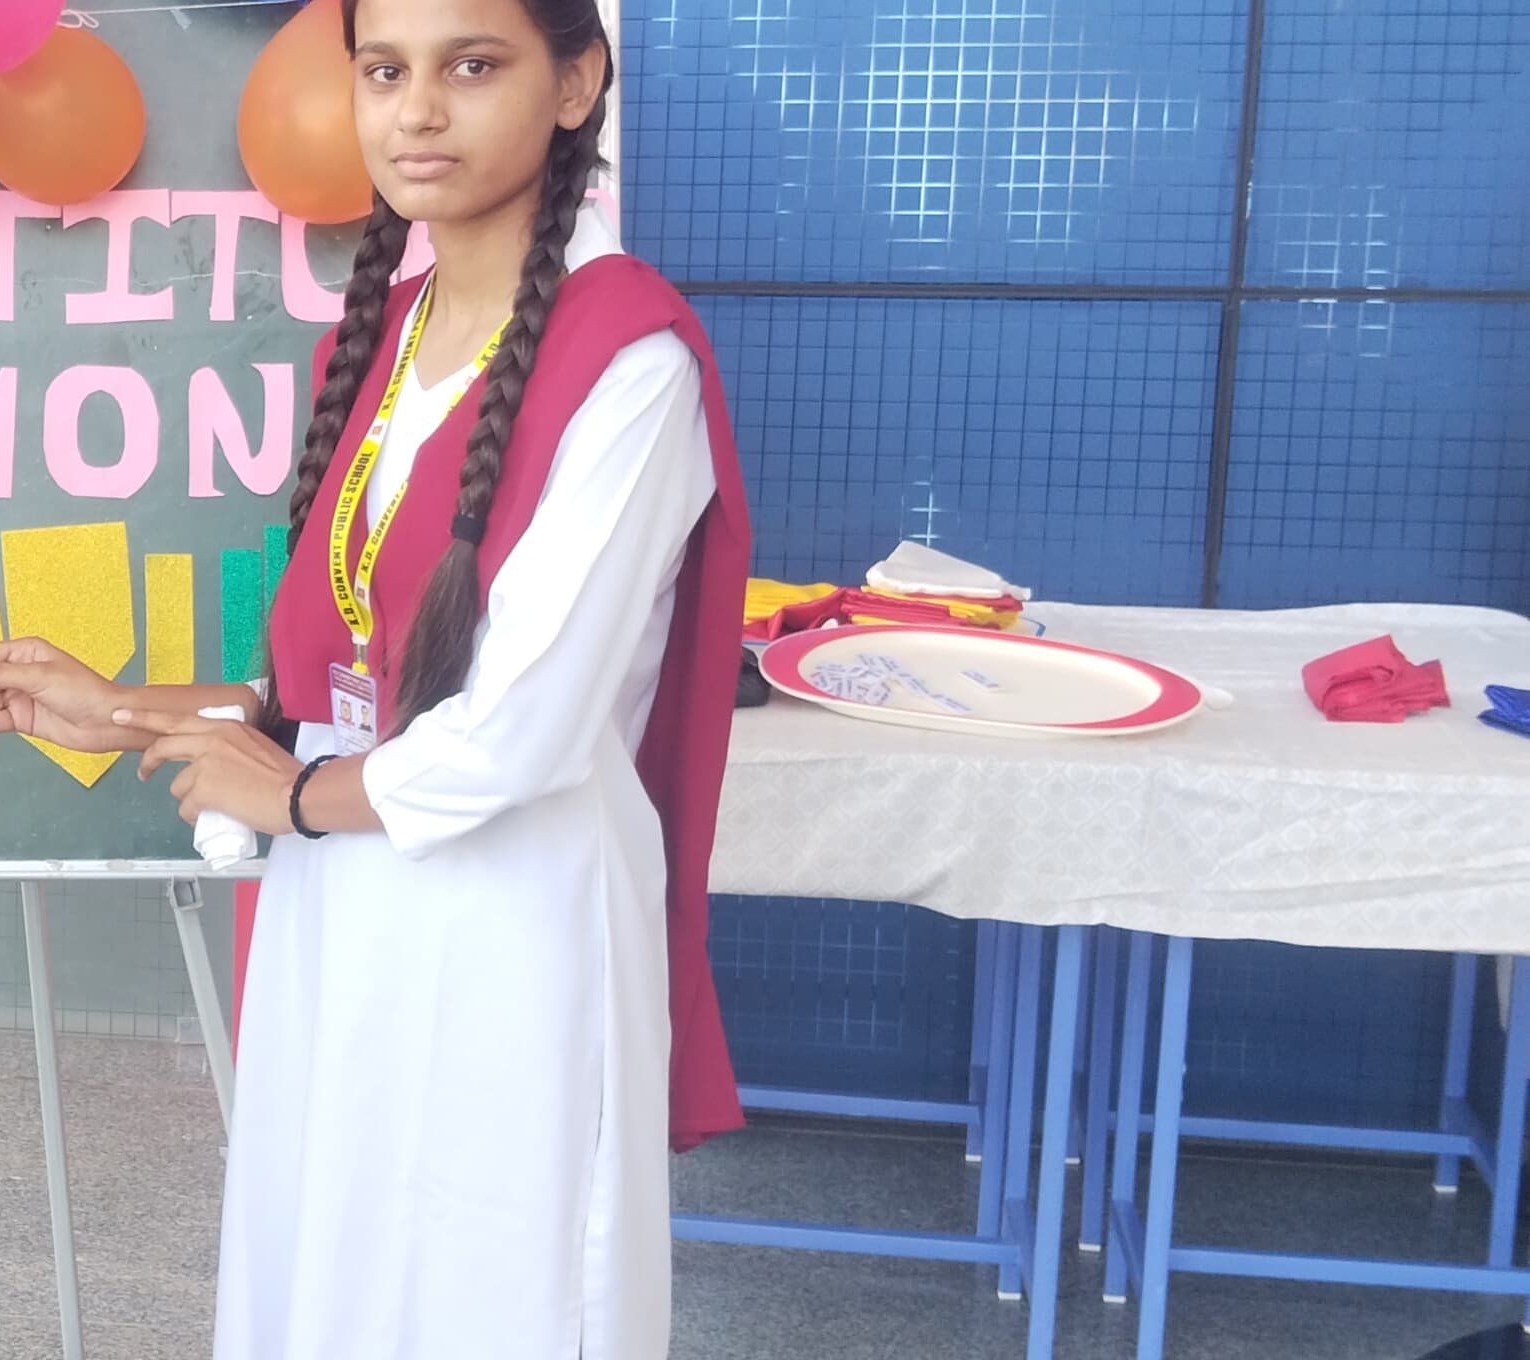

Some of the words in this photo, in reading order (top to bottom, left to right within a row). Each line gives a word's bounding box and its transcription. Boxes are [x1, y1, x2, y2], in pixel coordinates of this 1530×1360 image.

[345, 451, 374, 494] SCHOOL
[333, 496, 354, 541] PUBLIC
[333, 544, 349, 601] CONVENT
